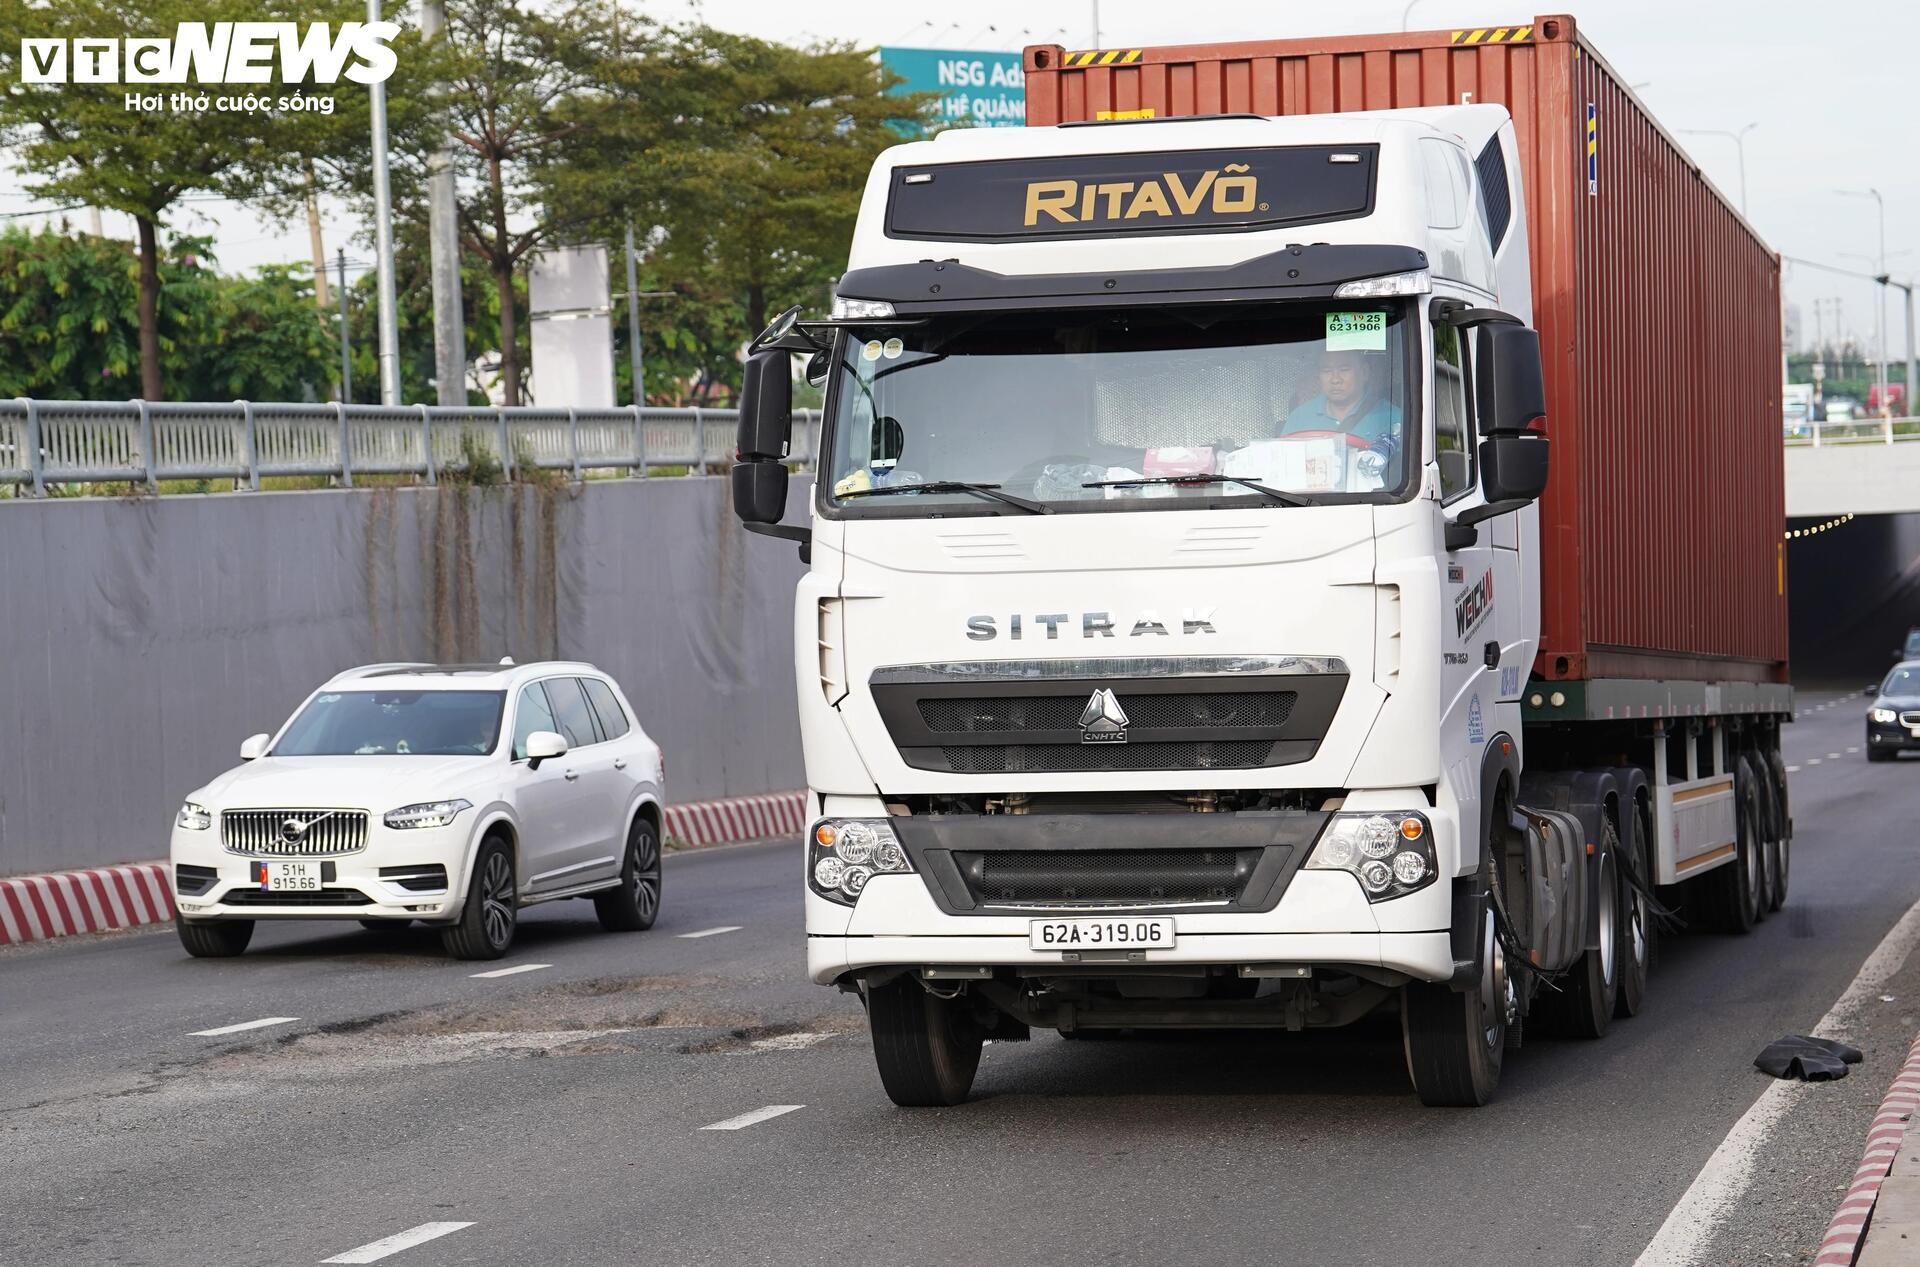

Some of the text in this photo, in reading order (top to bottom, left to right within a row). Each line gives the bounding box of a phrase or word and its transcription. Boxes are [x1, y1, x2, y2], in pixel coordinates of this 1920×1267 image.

[938, 59, 985, 87] NSG
[1366, 314, 1381, 323] 25
[966, 607, 1218, 641] SITRAK
[1083, 731, 1125, 741] CNHTC
[282, 864, 305, 876] 51H
[273, 877, 315, 889] 915.66
